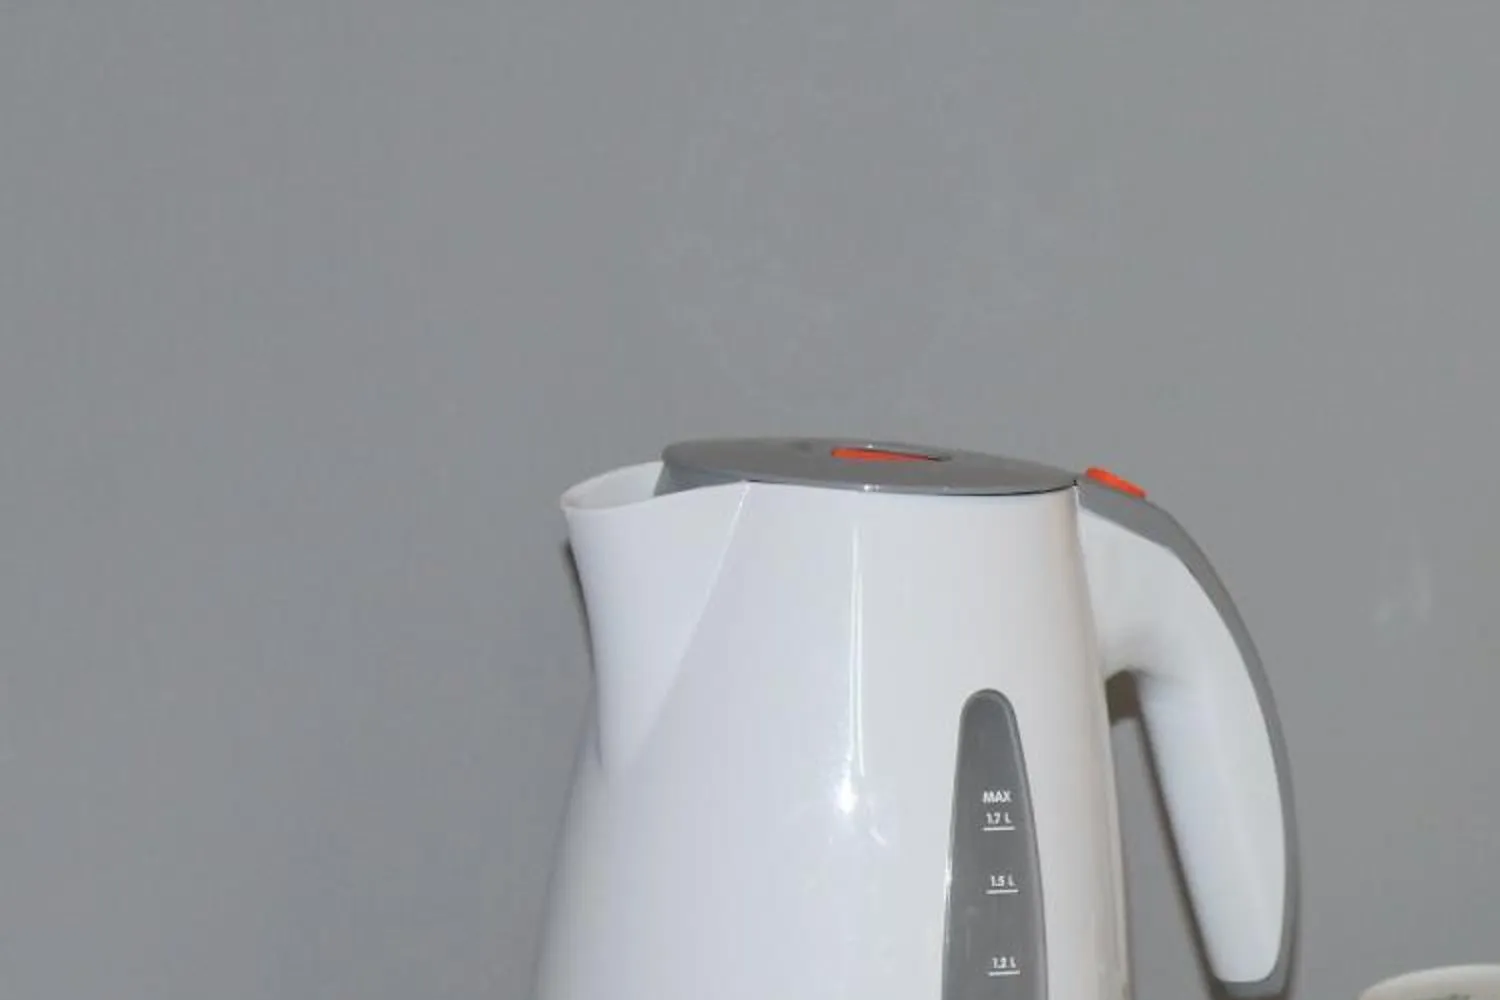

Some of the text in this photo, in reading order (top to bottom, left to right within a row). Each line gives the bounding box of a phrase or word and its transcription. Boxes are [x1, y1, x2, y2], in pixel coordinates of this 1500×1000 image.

[982, 790, 1012, 804] MAX
[1004, 811, 1012, 825] L
[990, 874, 1005, 887] 1.5
